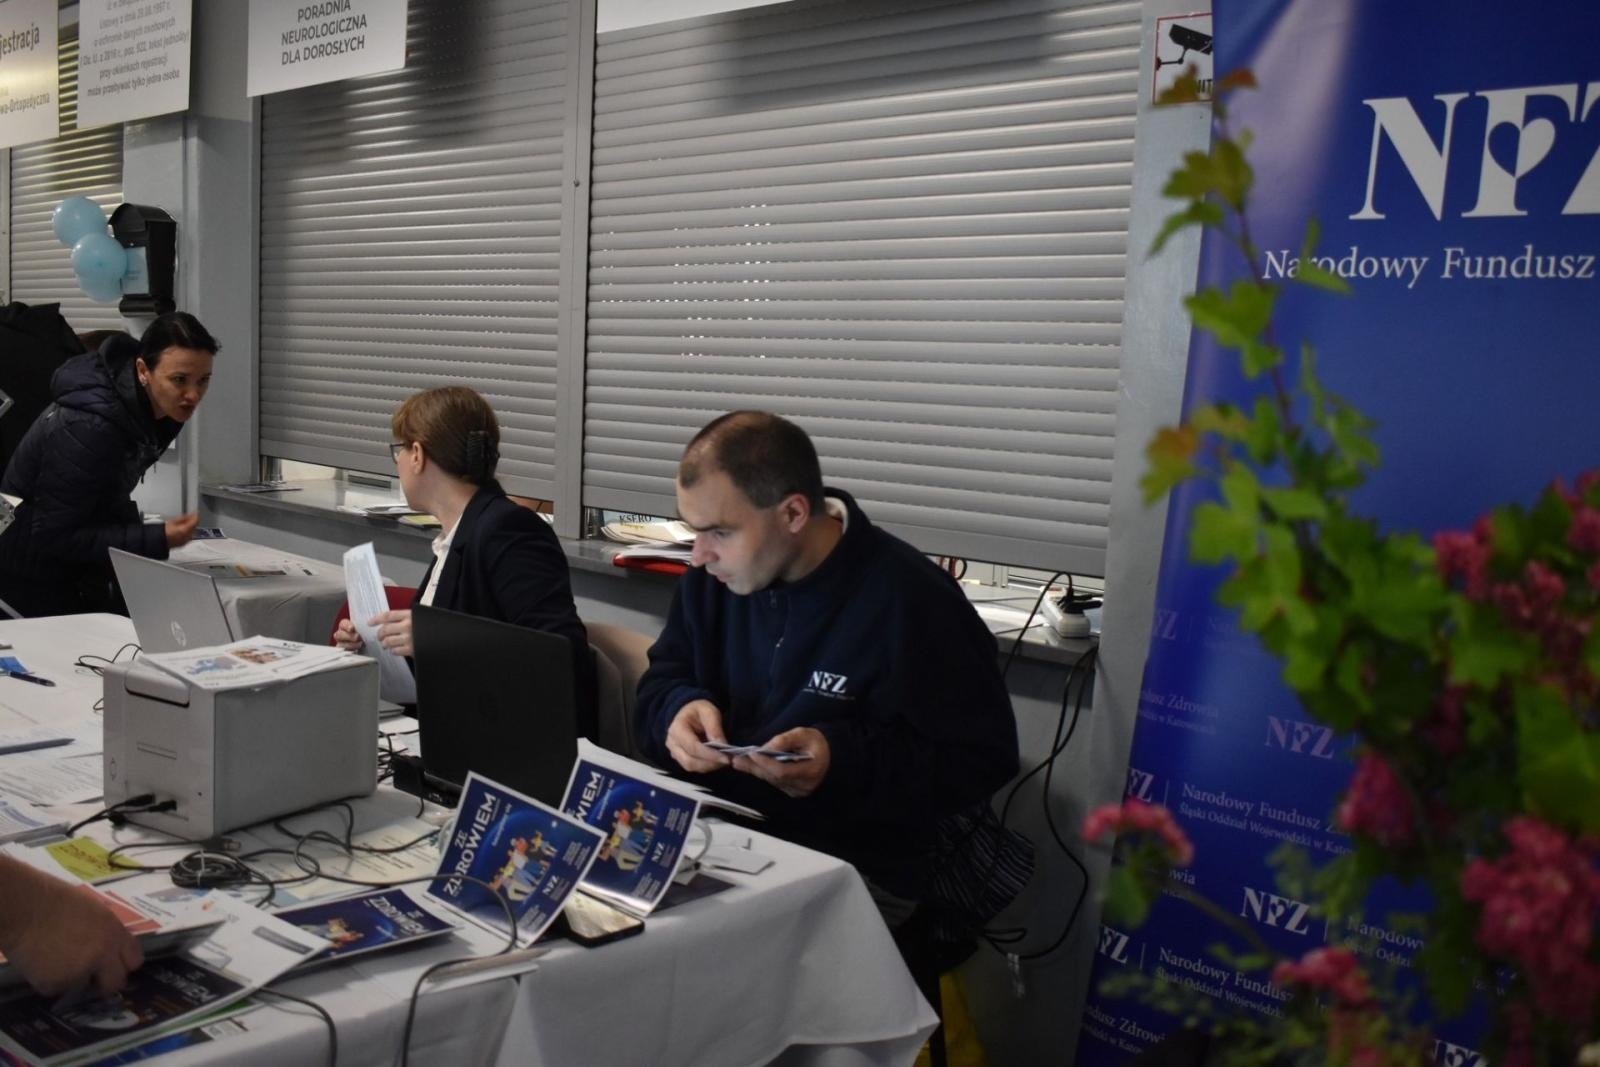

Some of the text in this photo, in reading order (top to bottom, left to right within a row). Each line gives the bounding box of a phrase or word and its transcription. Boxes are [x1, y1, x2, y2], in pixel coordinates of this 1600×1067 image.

[298, 0, 351, 22] PORADNIA
[281, 14, 367, 46] NEUROLOGICZNA
[281, 35, 365, 65] DLA DOROSŁYCH
[132, 76, 145, 90] tylko
[1262, 245, 1596, 289] Narodowy Fundusz
[808, 671, 848, 693] NFZ
[1264, 715, 1336, 760] NFZ
[1182, 783, 1255, 816] Narodowy
[1259, 801, 1321, 831] Fundusz
[454, 829, 468, 849] ZE
[1207, 811, 1248, 831] Oddział
[1249, 819, 1312, 847] Wojewódzki
[1240, 886, 1310, 936] NFZ
[1158, 946, 1231, 986] Narodowy
